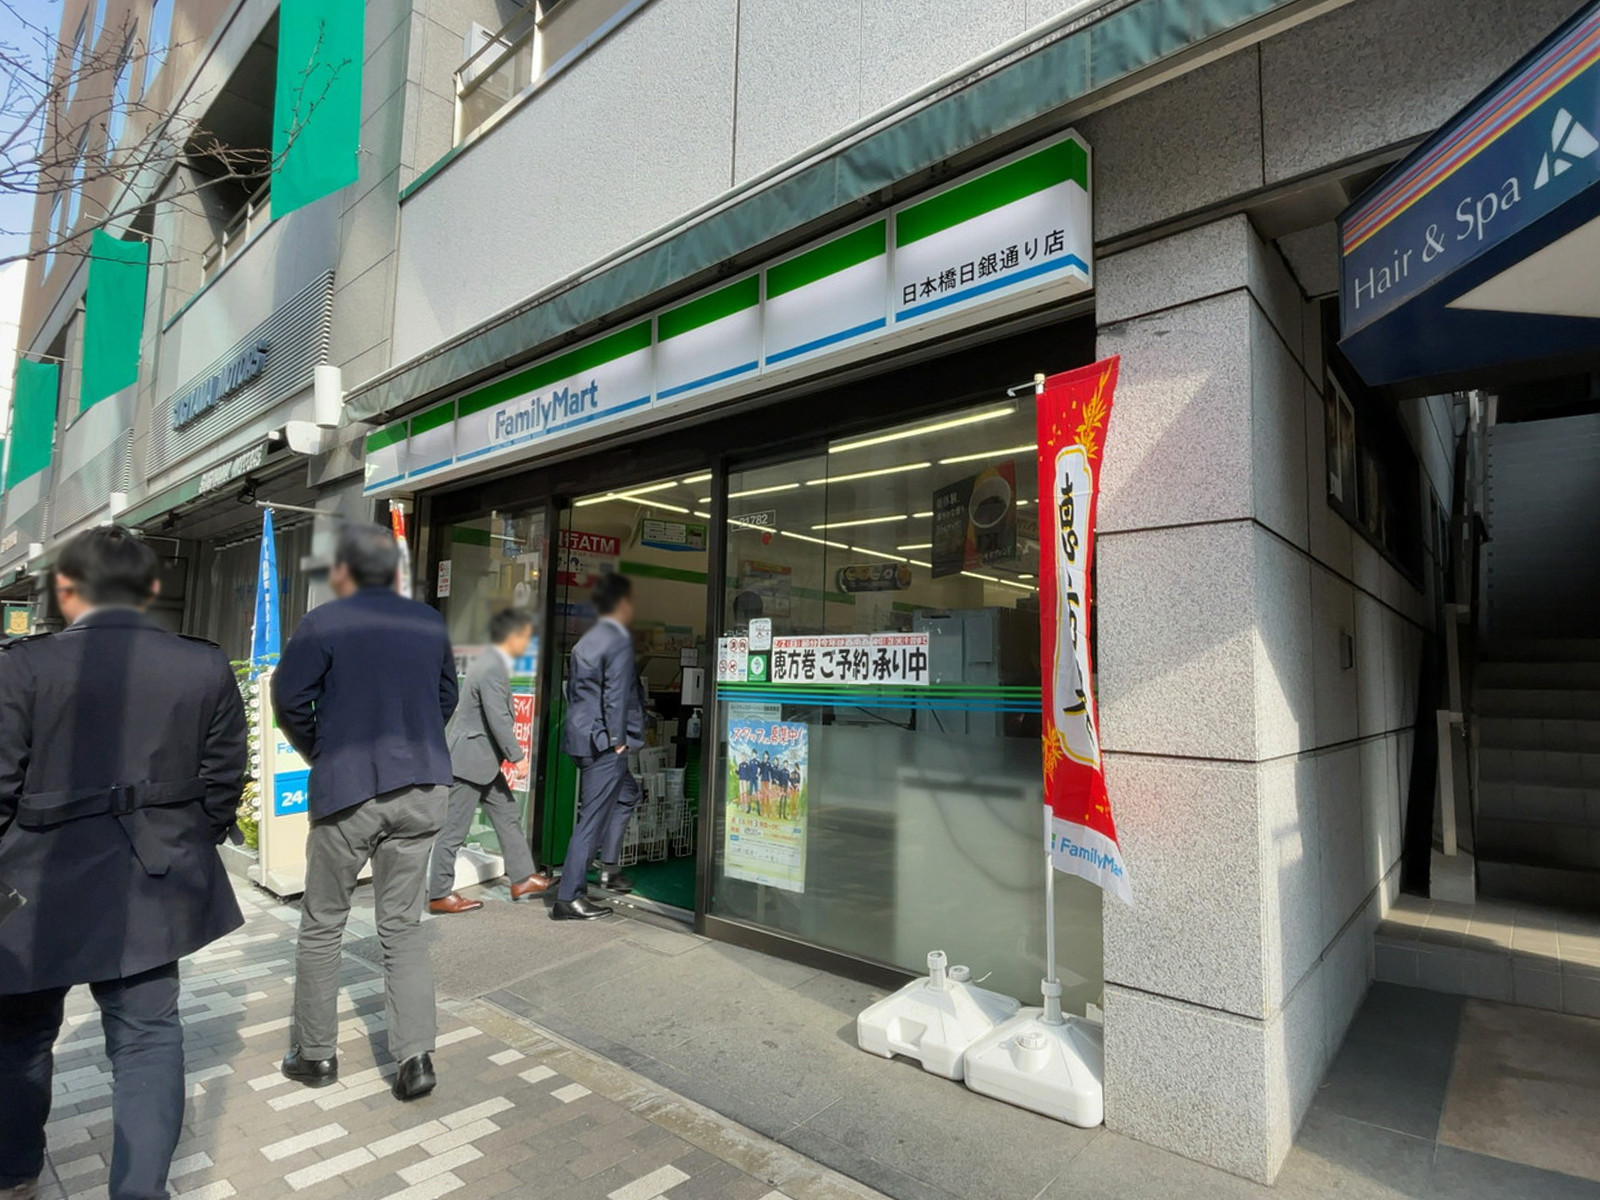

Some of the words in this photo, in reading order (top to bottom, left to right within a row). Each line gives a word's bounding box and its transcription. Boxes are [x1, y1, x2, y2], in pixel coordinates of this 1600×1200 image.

[903, 229, 1065, 305] 日本橋日銀通り店
[1354, 249, 1412, 309] Hair
[1422, 223, 1446, 263] &
[1455, 176, 1522, 241] Spa
[495, 379, 598, 439] FamilyMart
